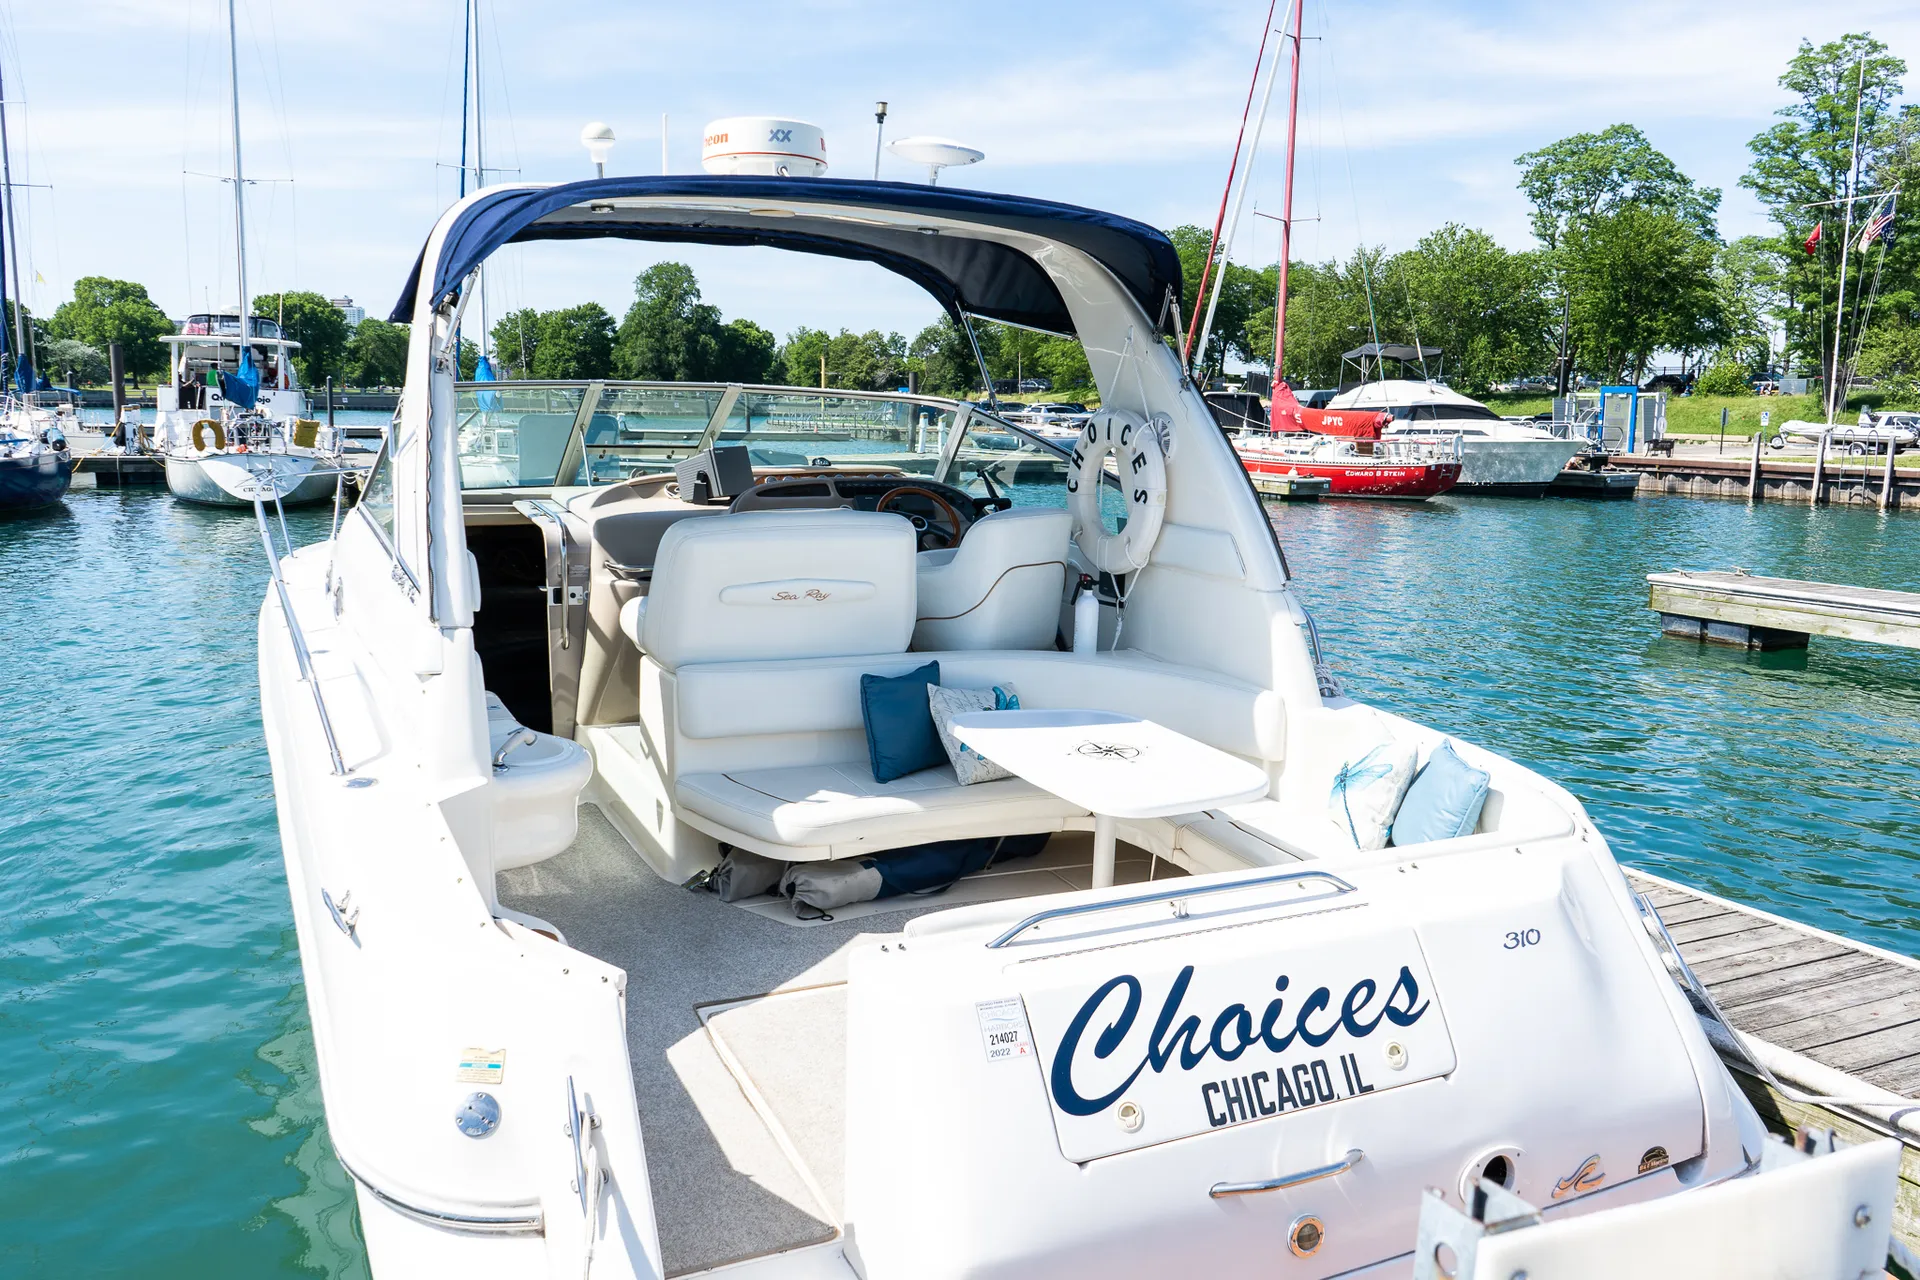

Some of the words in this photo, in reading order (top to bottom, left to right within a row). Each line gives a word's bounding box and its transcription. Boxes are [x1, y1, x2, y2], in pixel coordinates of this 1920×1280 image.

[768, 128, 792, 143] XX
[1321, 415, 1343, 426] JPYC
[1067, 418, 1148, 505] CHOICES
[772, 591, 799, 600] Sea
[804, 588, 831, 601] Ray
[1503, 928, 1541, 950] 310
[990, 1030, 1018, 1046] 214027
[1051, 965, 1430, 1116] Choices
[990, 1047, 1011, 1058] 2022
[1201, 1059, 1340, 1127] CHICAGO,
[1339, 1053, 1374, 1095] IL
